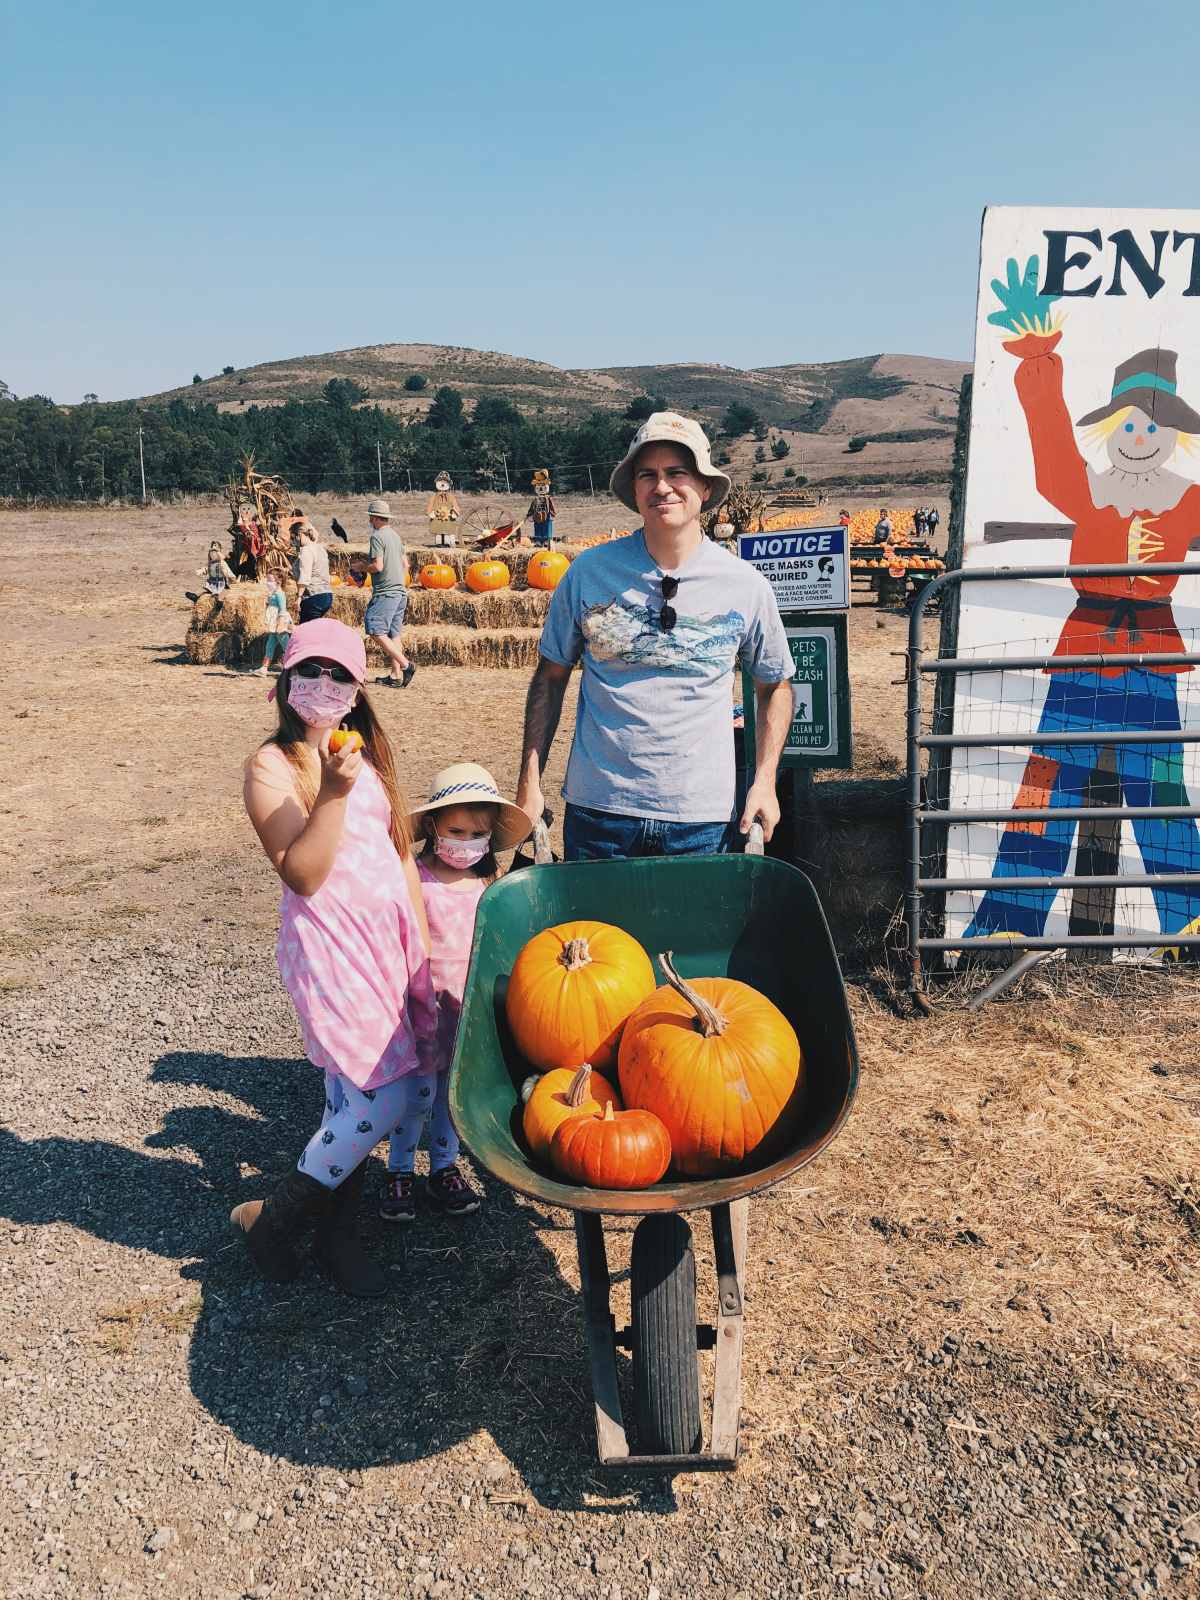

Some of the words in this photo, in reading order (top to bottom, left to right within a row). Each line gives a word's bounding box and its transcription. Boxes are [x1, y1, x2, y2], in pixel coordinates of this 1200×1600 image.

[752, 535, 832, 557] NOTICE
[752, 562, 775, 571] ACE
[778, 560, 814, 570] MASKS
[793, 641, 816, 653] PETS
[802, 655, 815, 667] BE
[793, 670, 823, 681] LEASH
[792, 724, 813, 734] CLEAN
[815, 724, 824, 734] UP
[790, 735, 809, 745] YOUR
[811, 735, 822, 745] PET
